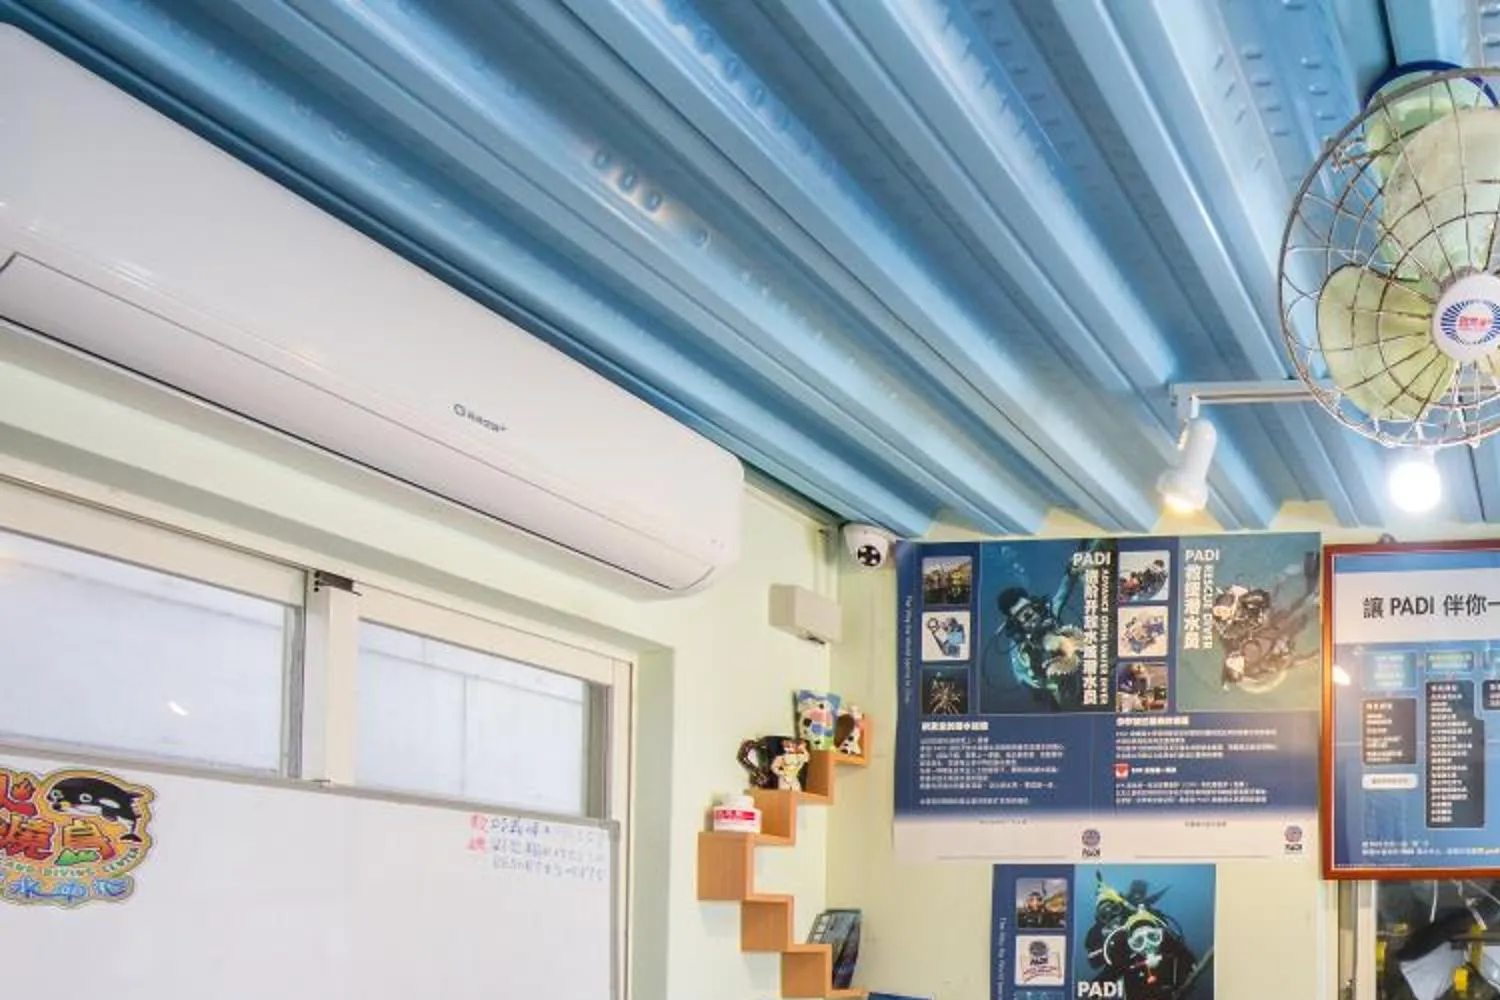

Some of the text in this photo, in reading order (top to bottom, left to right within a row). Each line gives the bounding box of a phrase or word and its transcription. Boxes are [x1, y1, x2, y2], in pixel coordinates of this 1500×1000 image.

[1073, 552, 1111, 566] PADI
[1185, 549, 1220, 561] PADI
[1363, 597, 1384, 619] 讓
[1390, 597, 1435, 616] PADI
[1077, 981, 1124, 997] PADI
